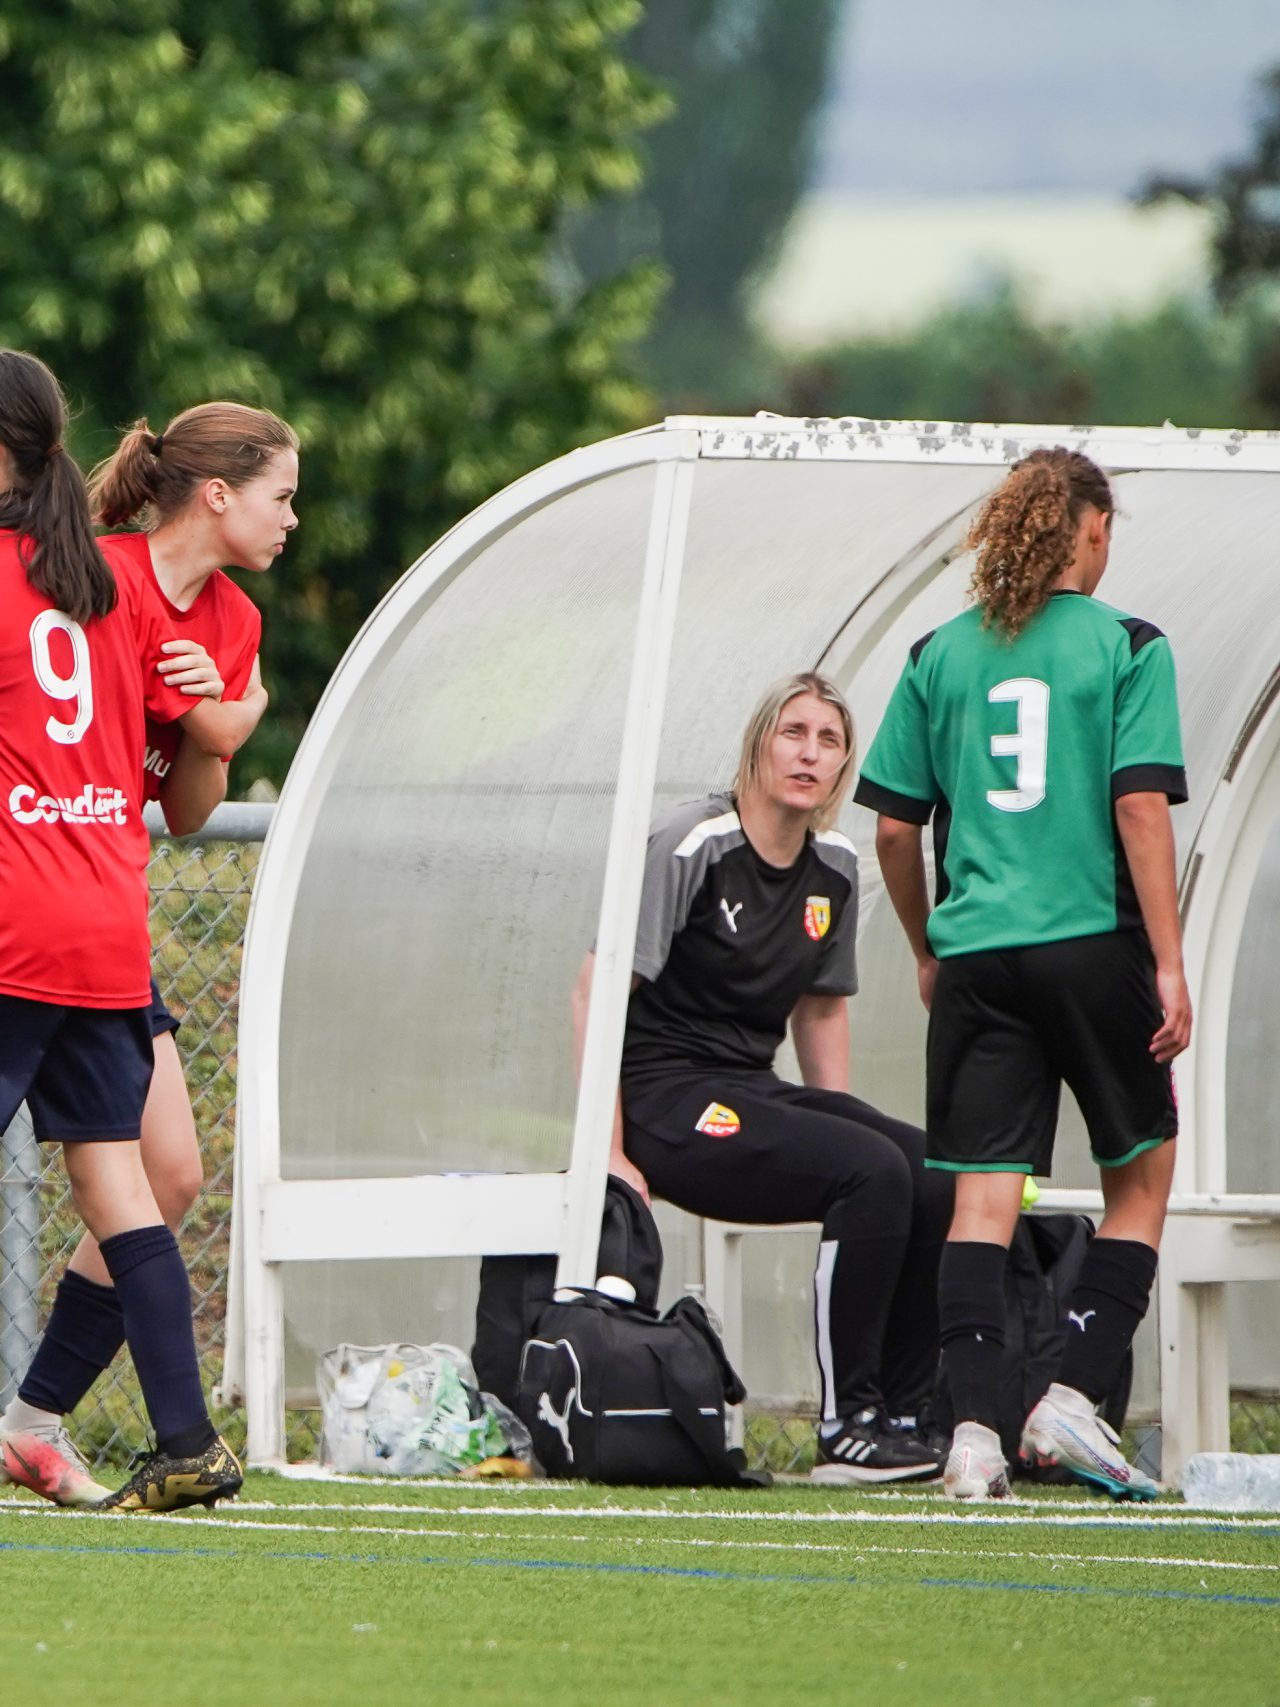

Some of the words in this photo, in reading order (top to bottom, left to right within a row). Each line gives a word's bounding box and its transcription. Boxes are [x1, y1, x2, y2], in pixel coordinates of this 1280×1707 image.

[29, 608, 94, 744] 9
[9, 783, 128, 825] Coudert
[987, 677, 1050, 812] 3
